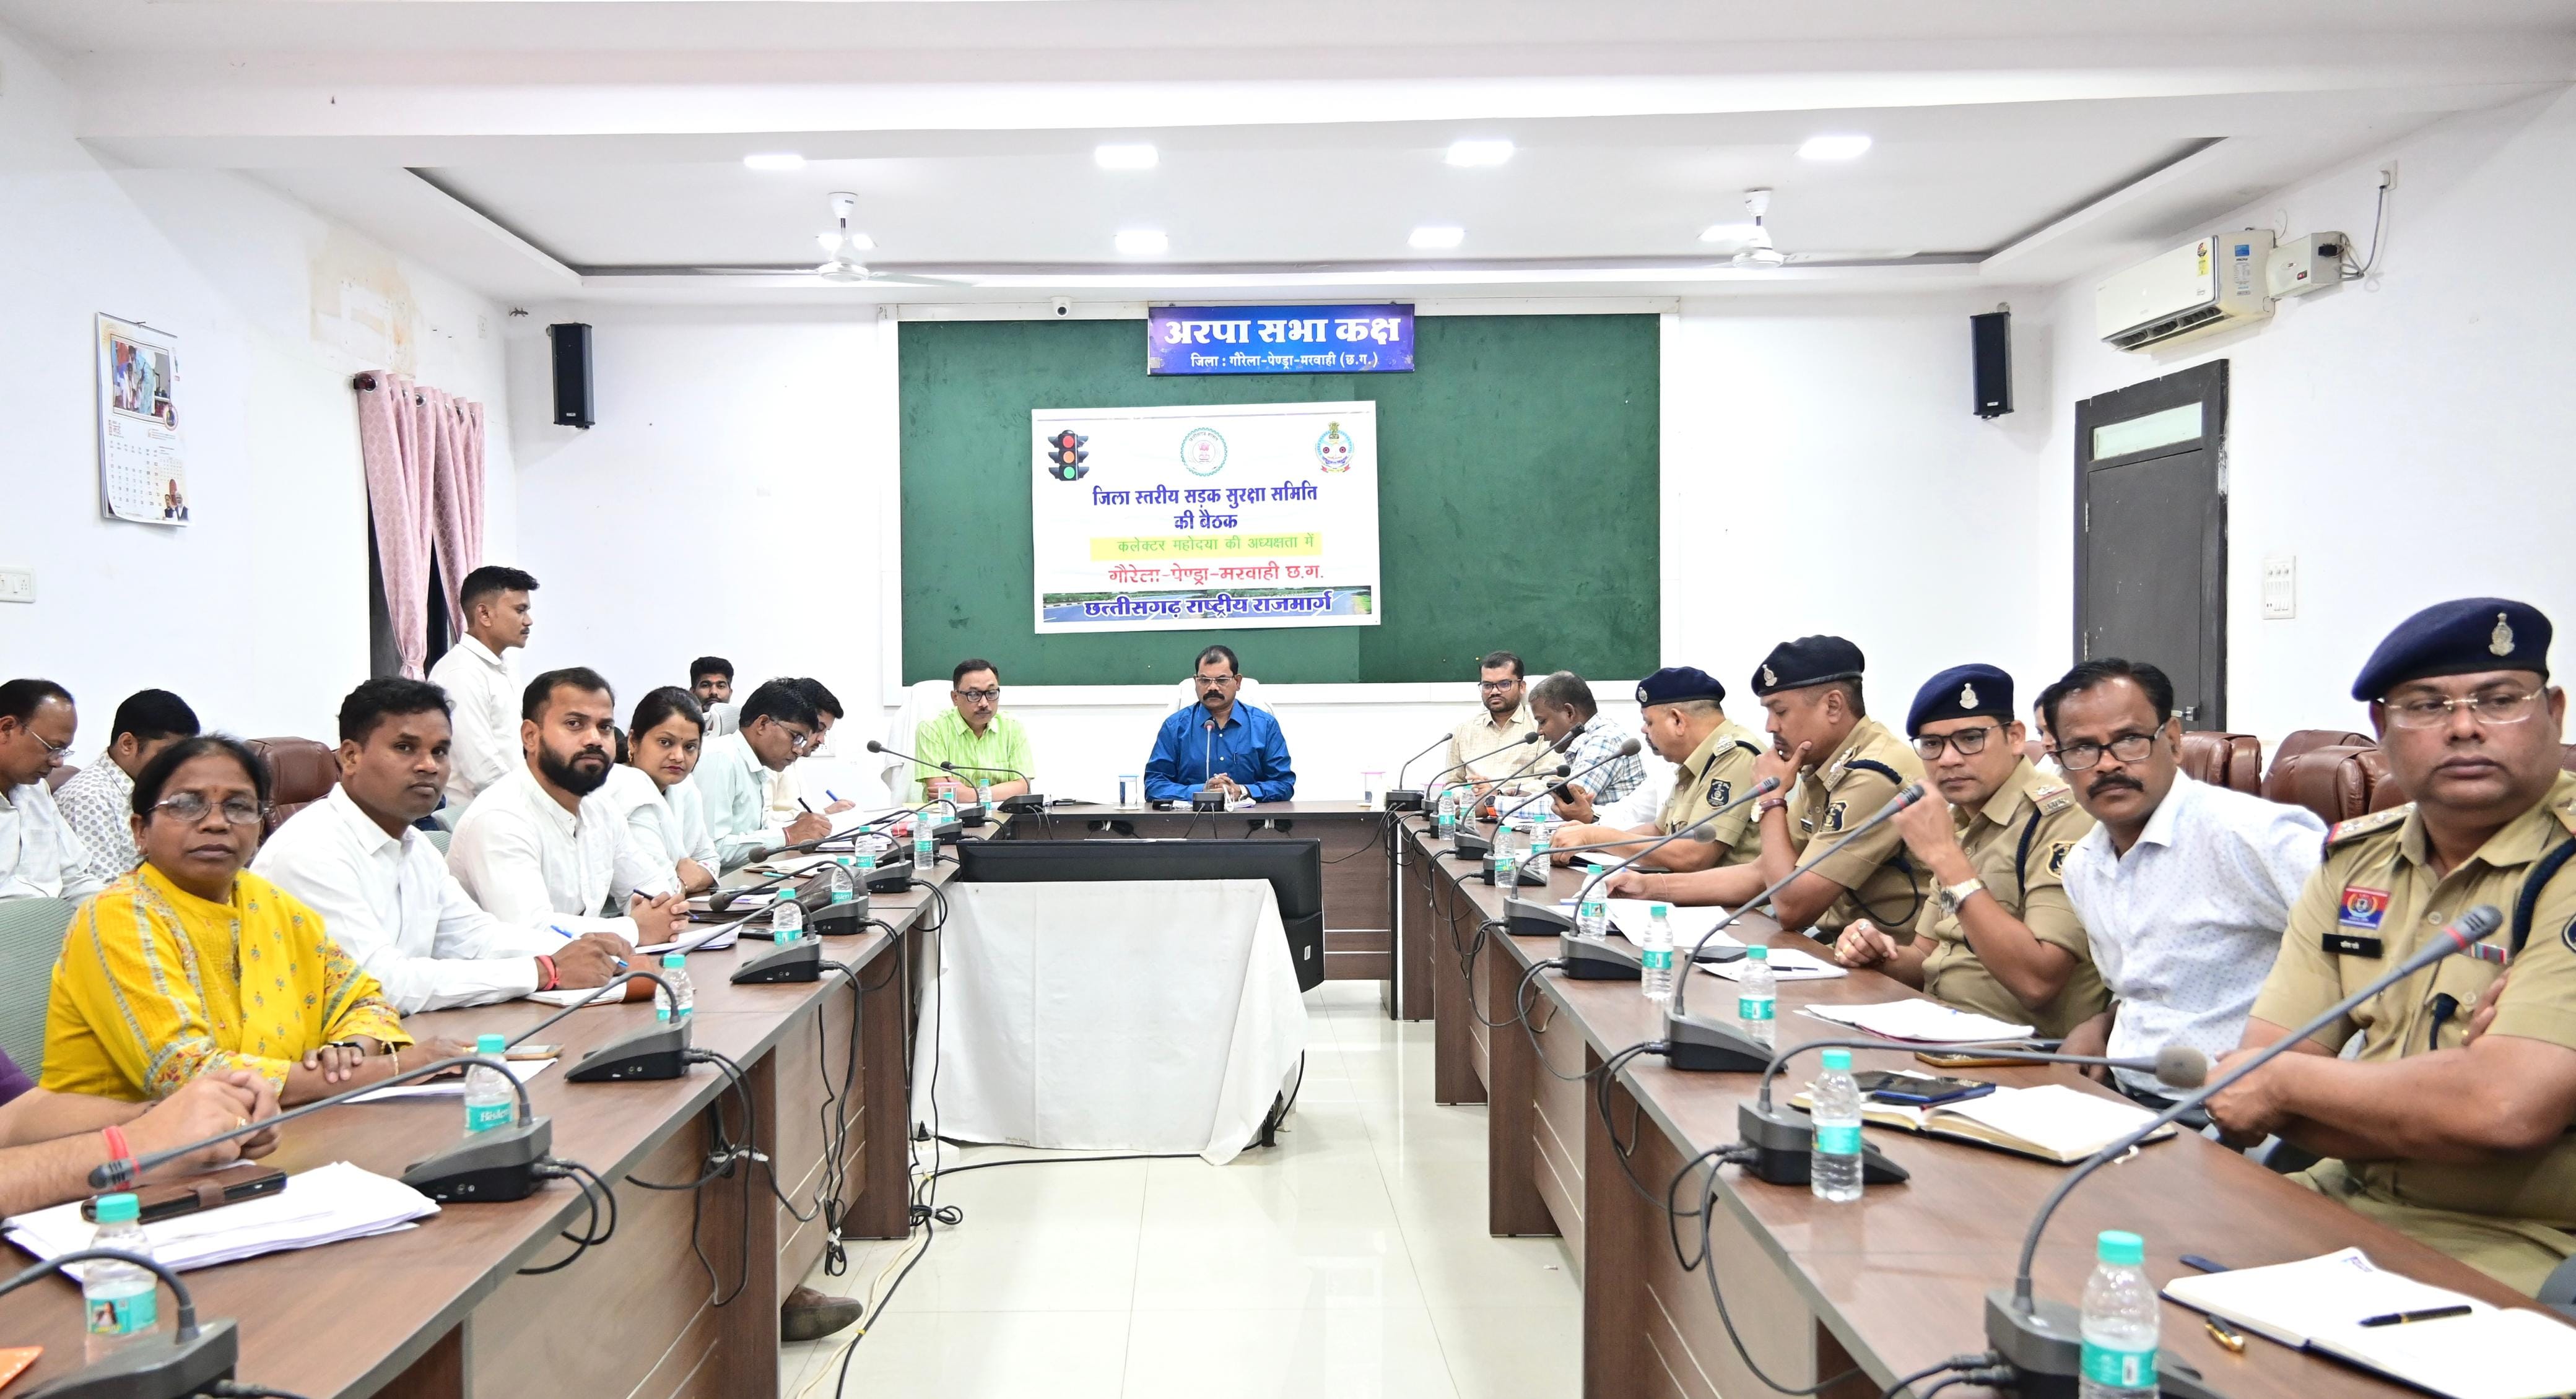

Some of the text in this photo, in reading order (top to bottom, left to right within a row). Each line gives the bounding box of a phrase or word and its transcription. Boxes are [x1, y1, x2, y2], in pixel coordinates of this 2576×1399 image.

[1164, 318, 1401, 345] अरपा सभा कक्ष
[1191, 353, 1219, 367] जिला
[1093, 480, 1318, 509] जिला स्तरीय सड़क सुरक्षा समिति
[1174, 508, 1238, 530] की बैठक
[1118, 532, 1314, 552] कलेक्टर महोदया की अध्यक्षता में
[1084, 590, 1333, 619] छत्तीसगढ़ राष्ट्रीय राजमार्ग
